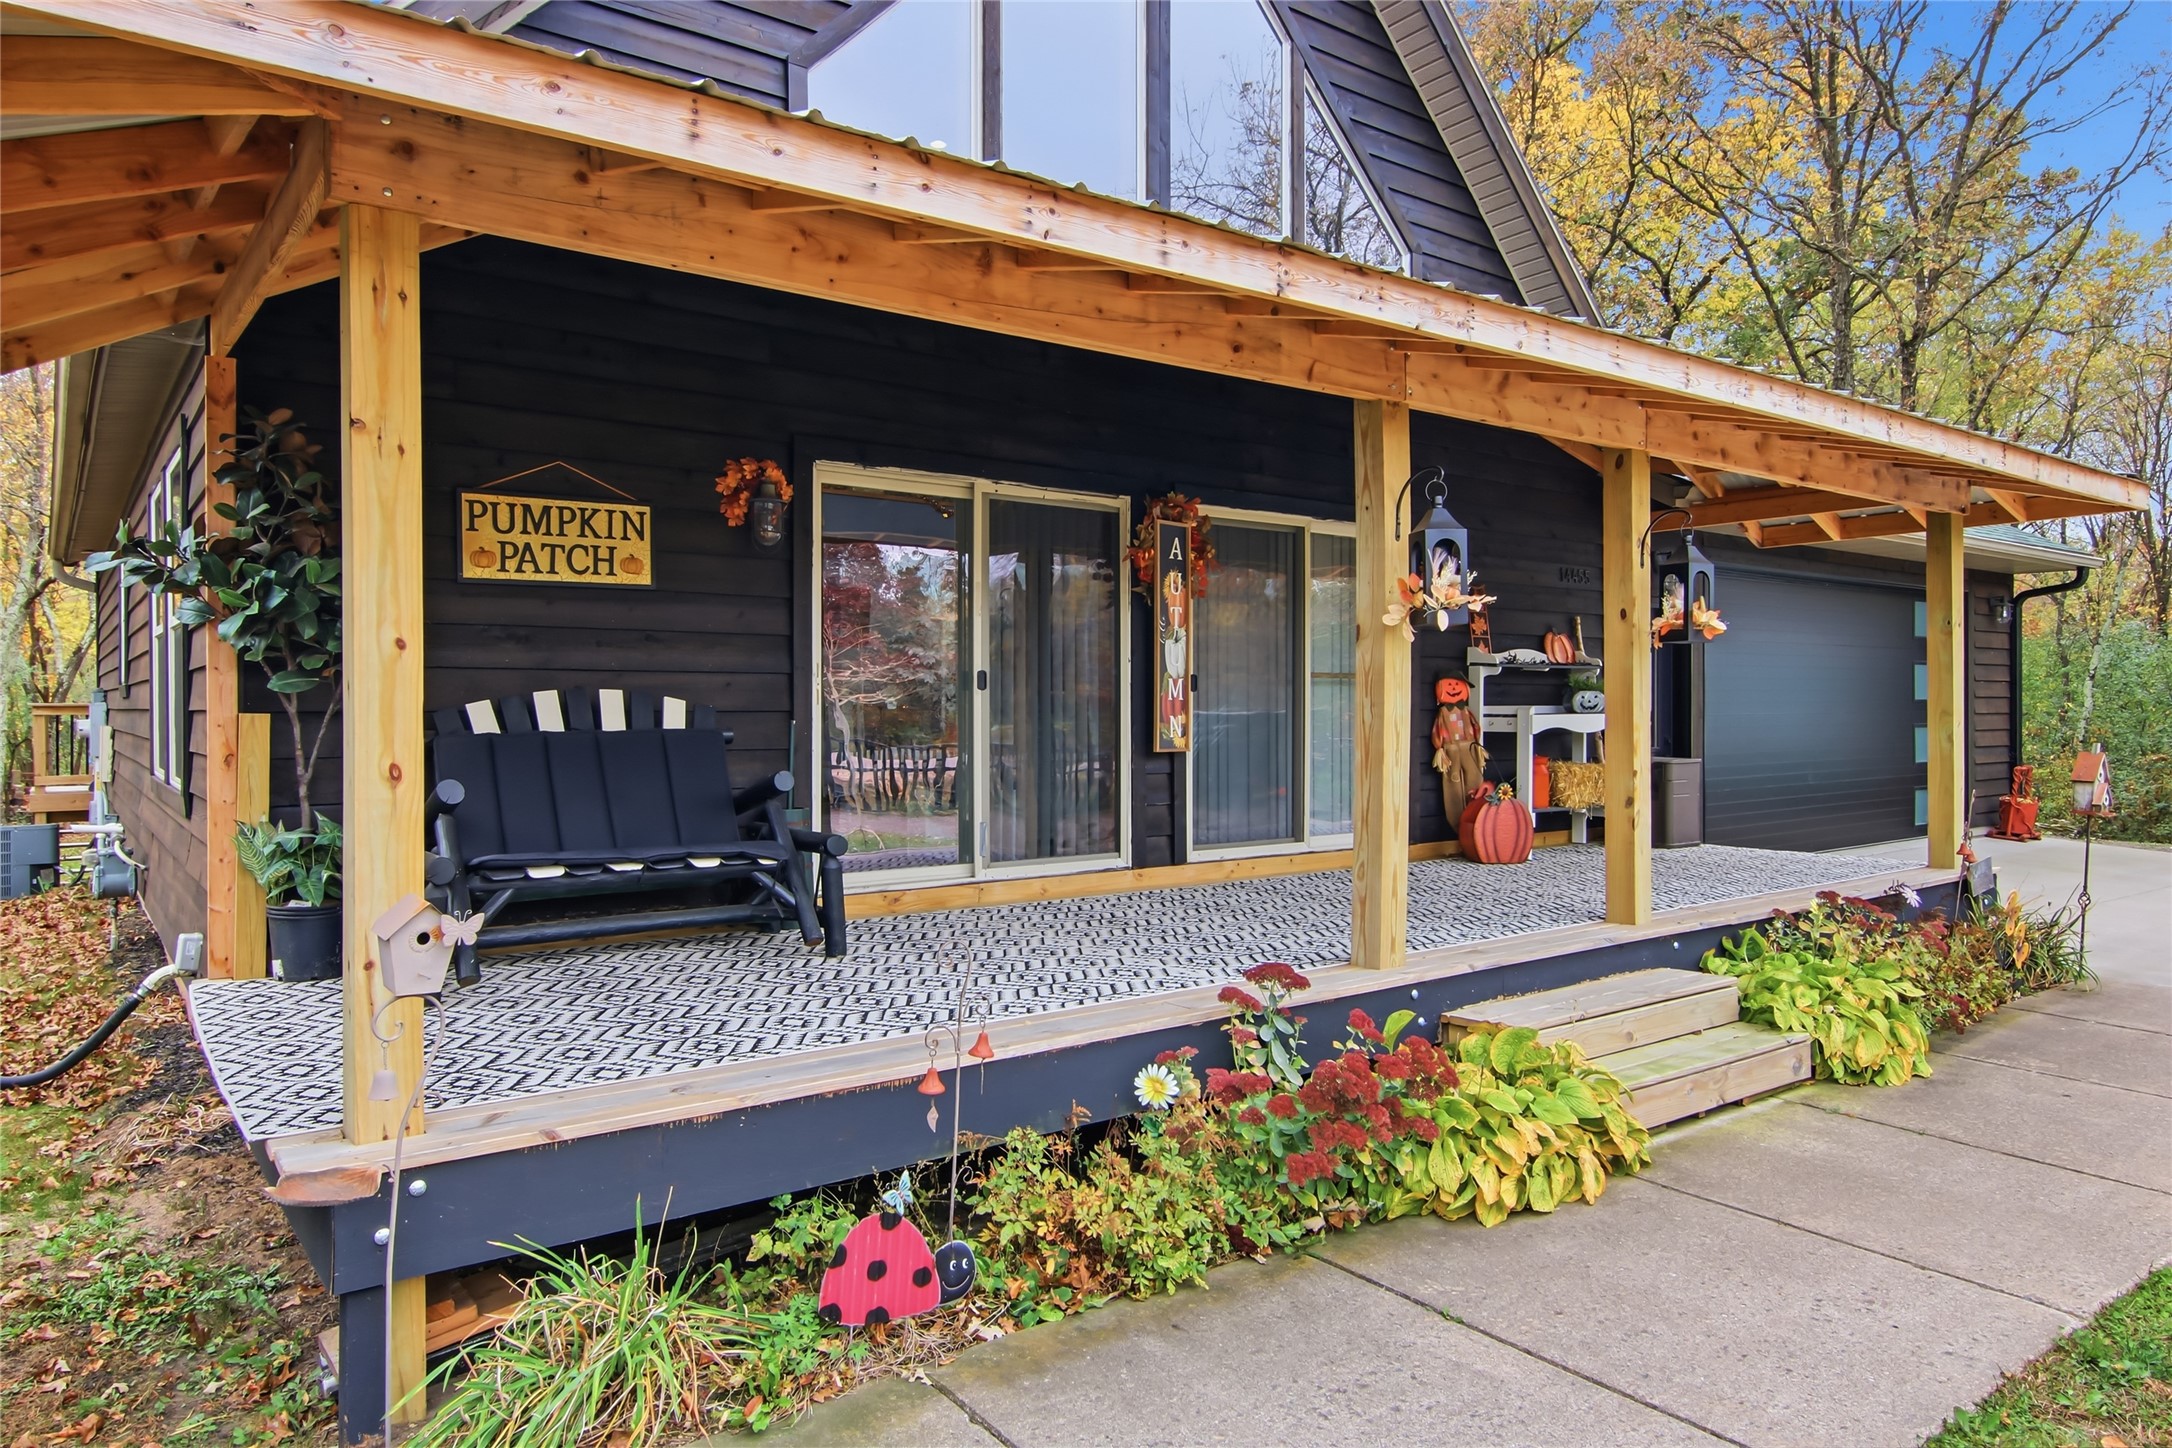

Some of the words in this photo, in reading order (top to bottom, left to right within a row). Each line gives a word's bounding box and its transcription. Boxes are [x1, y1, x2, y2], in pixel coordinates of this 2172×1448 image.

[465, 499, 647, 541] PUMPKIN
[496, 540, 618, 576] PATCH
[1168, 537, 1184, 737] AUTUMN
